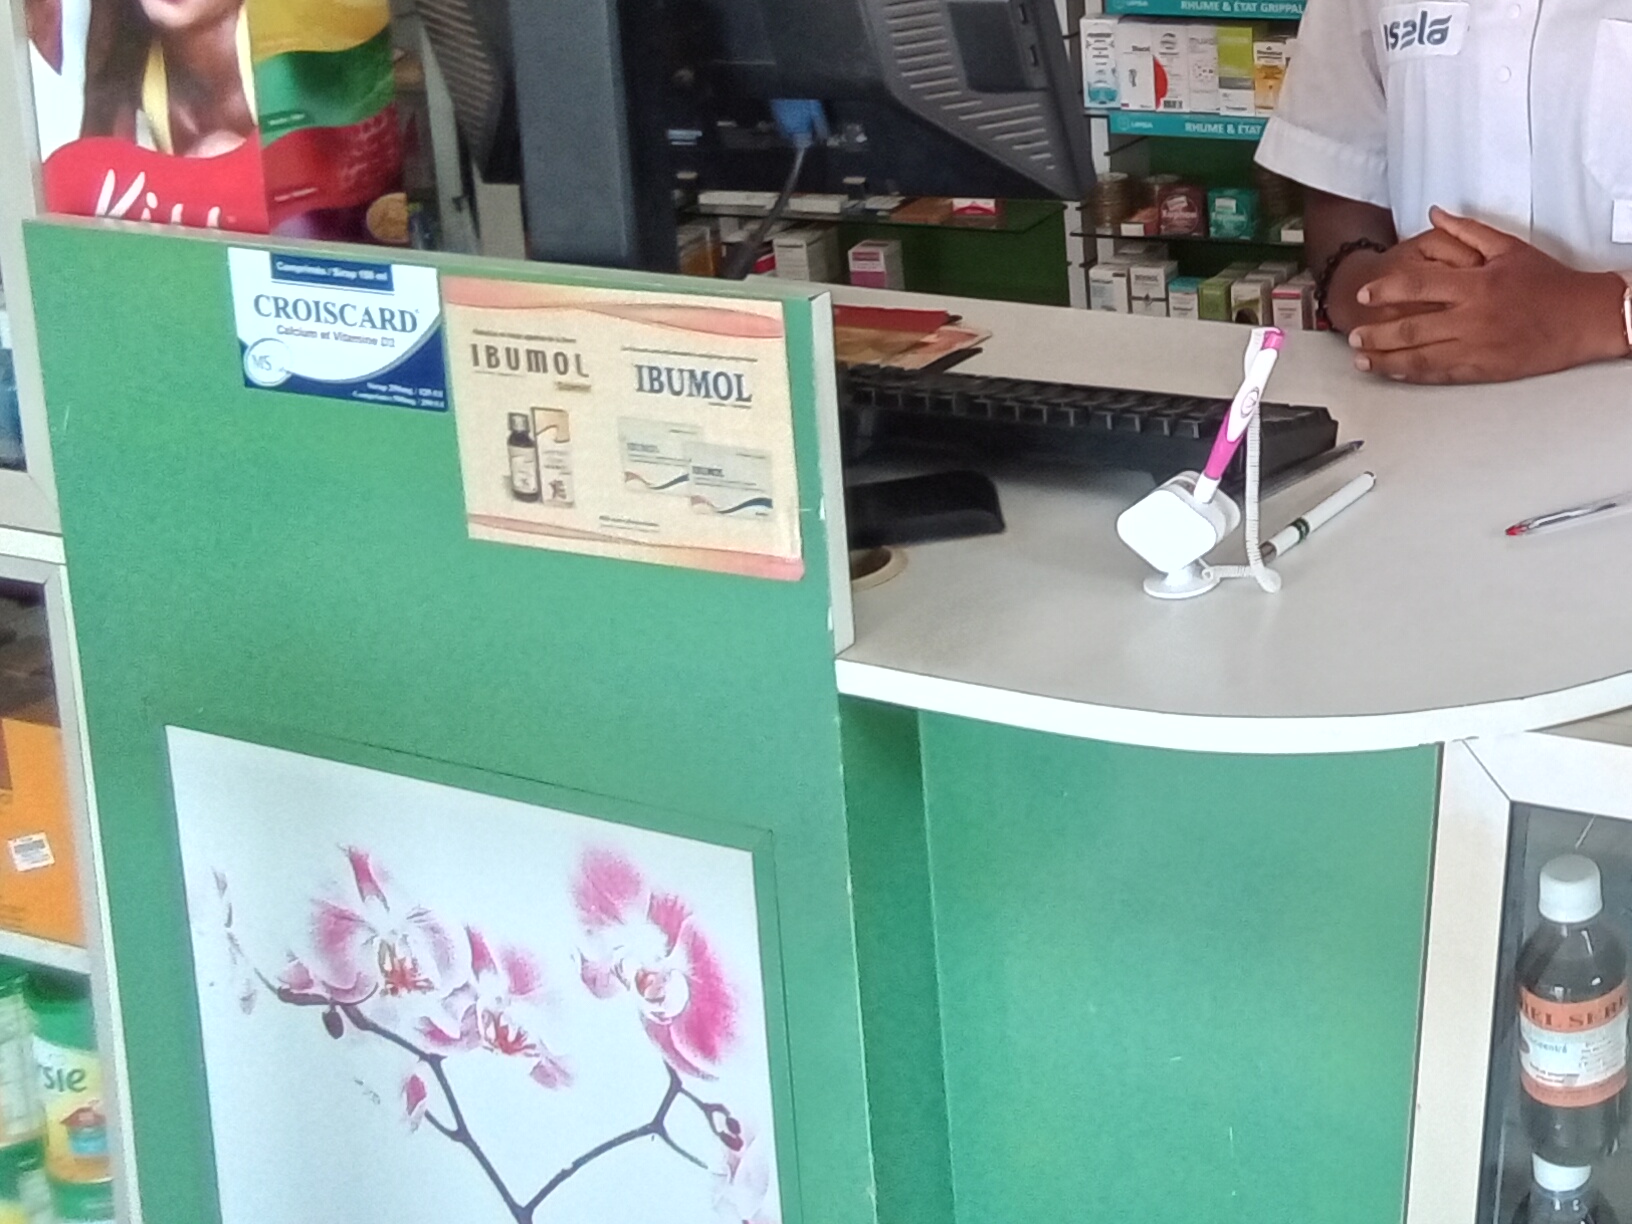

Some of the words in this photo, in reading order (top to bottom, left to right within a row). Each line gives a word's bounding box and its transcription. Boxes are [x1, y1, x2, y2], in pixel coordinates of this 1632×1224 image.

[1181, 0, 1219, 11] RHUME
[1222, 1, 1231, 12] &
[1185, 122, 1223, 133] RHUME
[1227, 123, 1235, 134] &
[1238, 121, 1261, 135] ÉTAT
[253, 293, 418, 334] CROISCARD
[276, 325, 319, 340] Calcium
[321, 331, 331, 340] et
[333, 331, 378, 346] Vitamine
[471, 343, 590, 378] IBUMOL
[635, 363, 753, 403] IBUMOL
